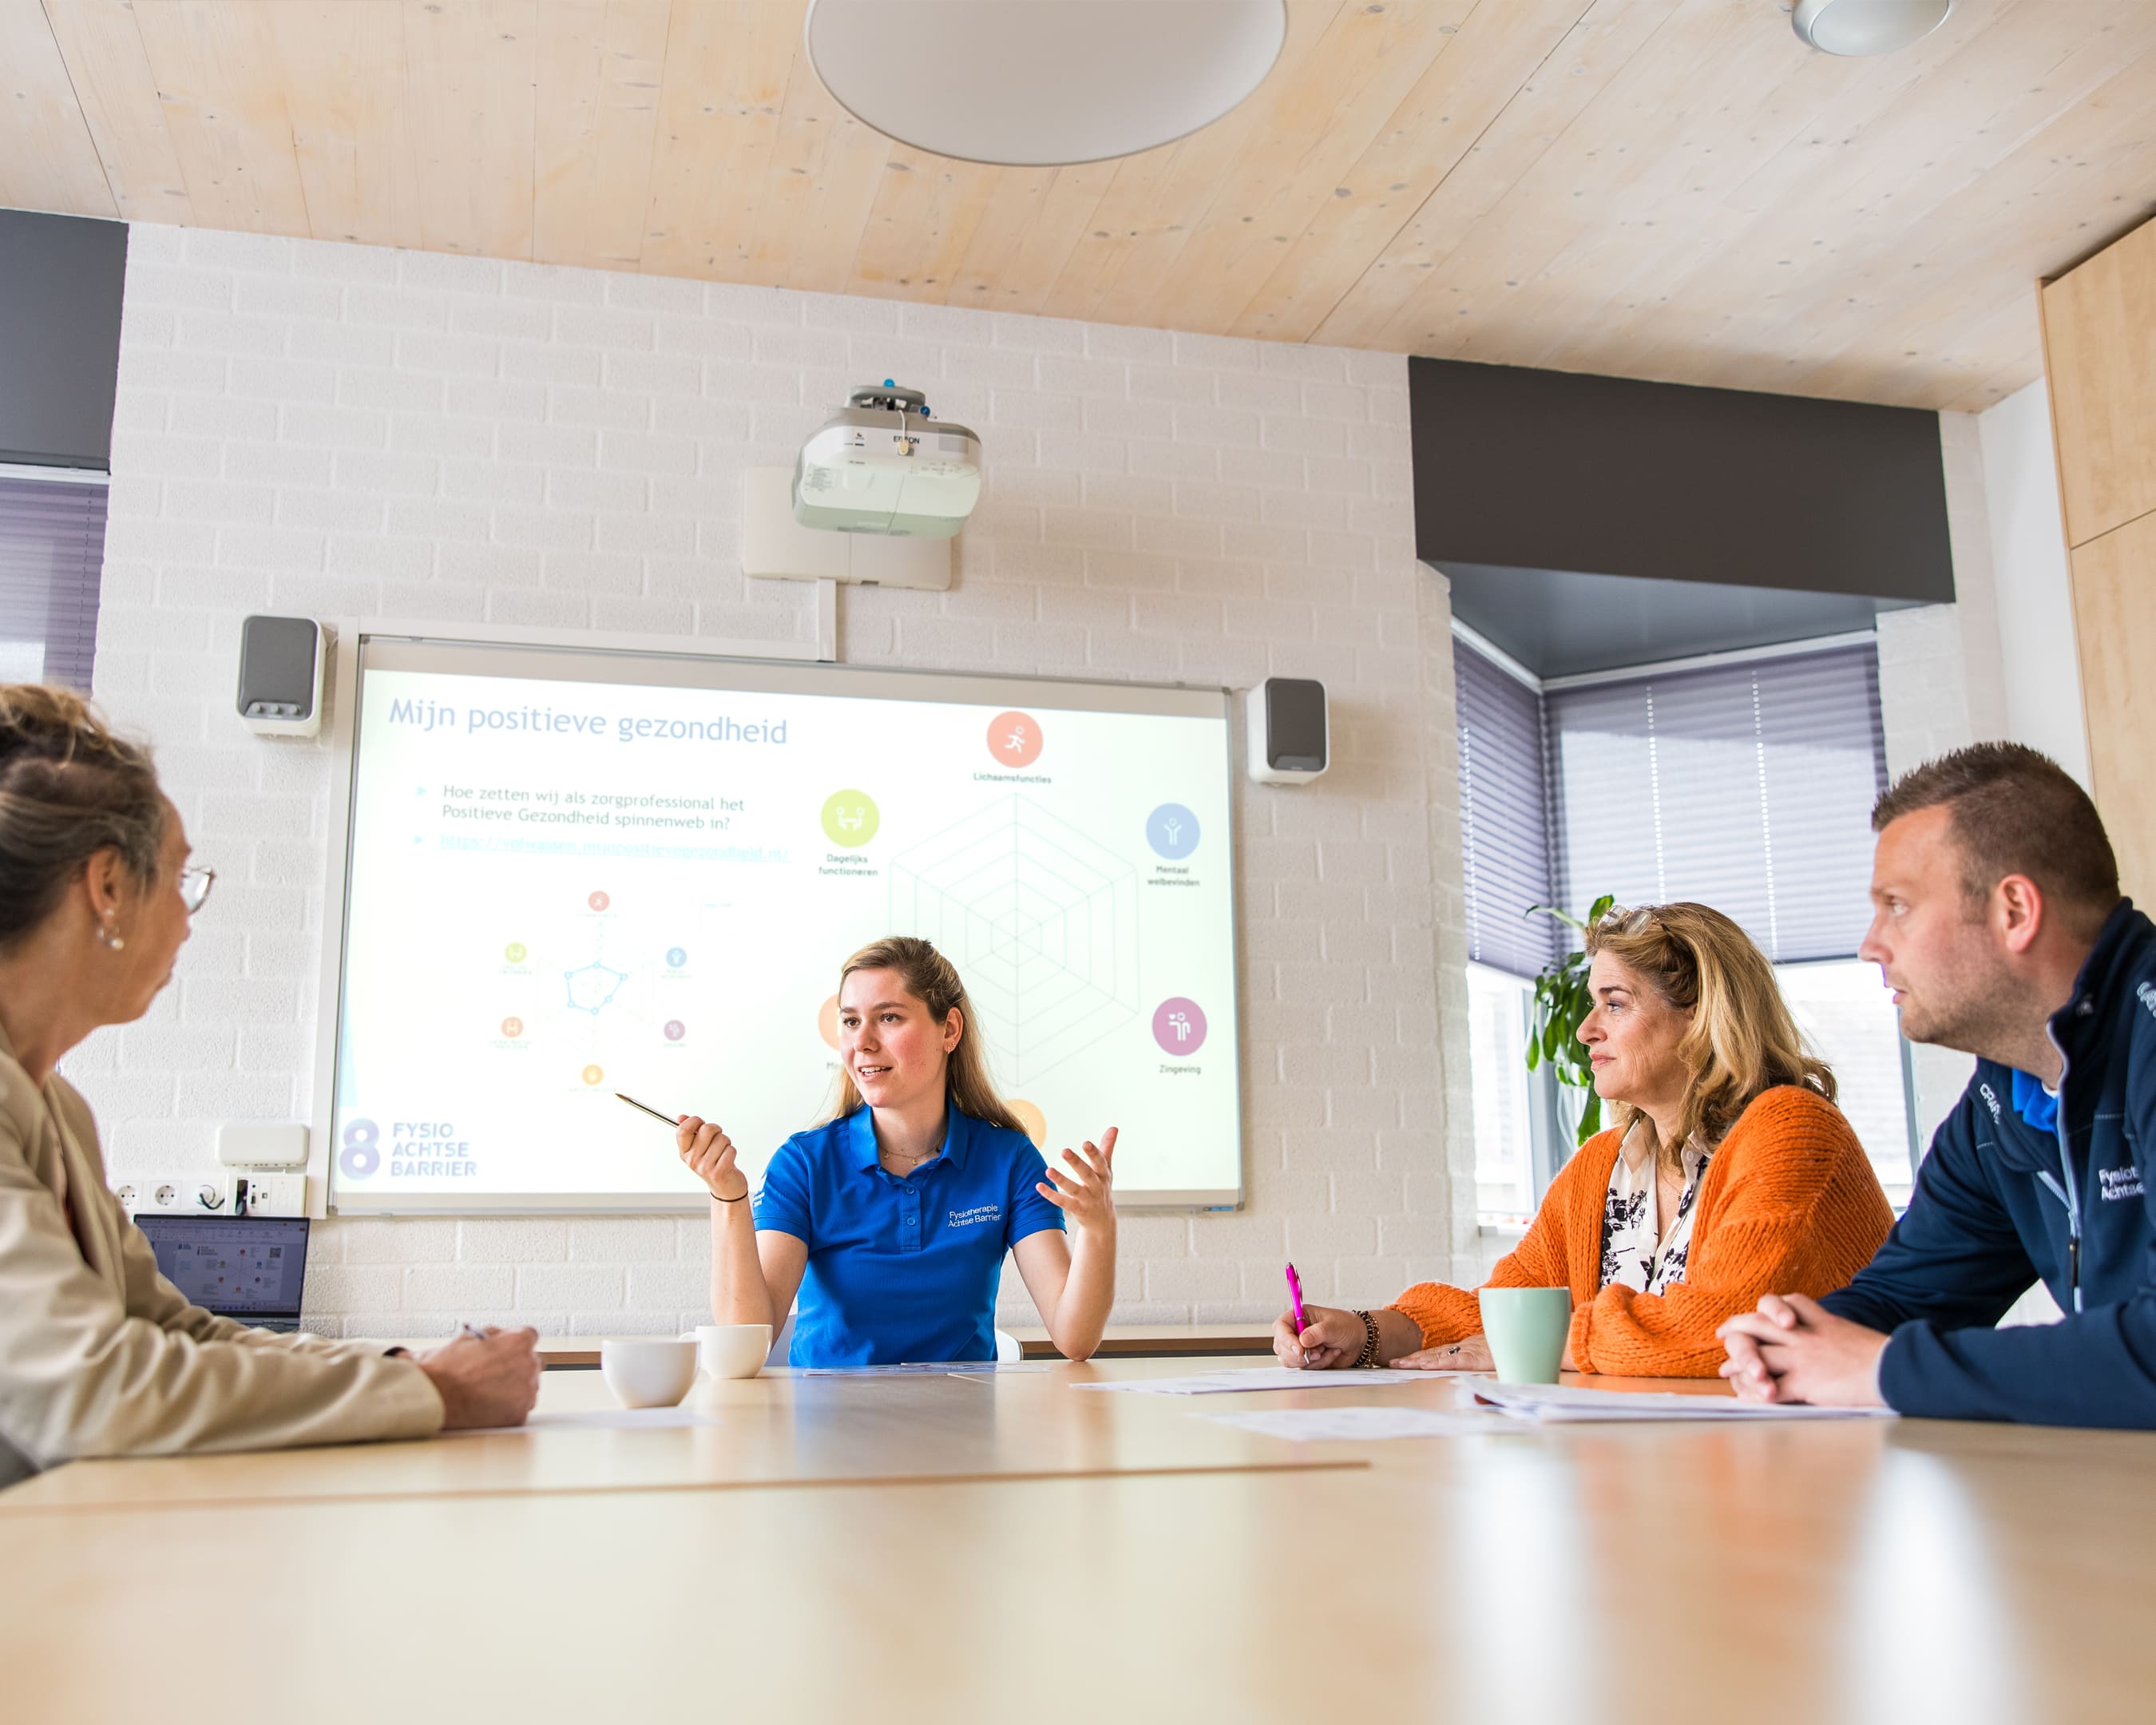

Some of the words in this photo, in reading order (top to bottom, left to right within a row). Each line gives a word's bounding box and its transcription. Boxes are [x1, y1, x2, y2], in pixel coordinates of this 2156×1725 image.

[894, 435, 920, 445] EPON
[388, 697, 455, 732] Mijn
[468, 705, 607, 736] positieve
[618, 716, 787, 744] gezondheid
[973, 772, 1052, 784] Lichaamsfuncties
[443, 785, 474, 799] Hoe
[479, 787, 530, 802] zetten
[536, 789, 560, 806] wij
[565, 791, 586, 804] als
[591, 794, 715, 810] zorgprofessional
[720, 796, 745, 811] het
[442, 804, 513, 821] Positieve
[518, 808, 610, 825] Gezondheid
[615, 813, 705, 829] spinnenweb
[711, 816, 730, 831] in?
[826, 853, 869, 866] Dagelijks
[818, 866, 879, 877] functioneren
[1155, 865, 1189, 874] Mentaal
[1147, 877, 1200, 887] welbevinden
[1159, 1064, 1202, 1076] Zingeving
[393, 1122, 454, 1139] FYSIO
[392, 1141, 470, 1158] ACHTSE
[390, 1160, 478, 1178] BARRIER
[2099, 1166, 2140, 1188] Fysiot
[948, 1215, 974, 1227] Achtse
[974, 1213, 1002, 1223] Barrier
[949, 1204, 998, 1221] Fysiotherapie
